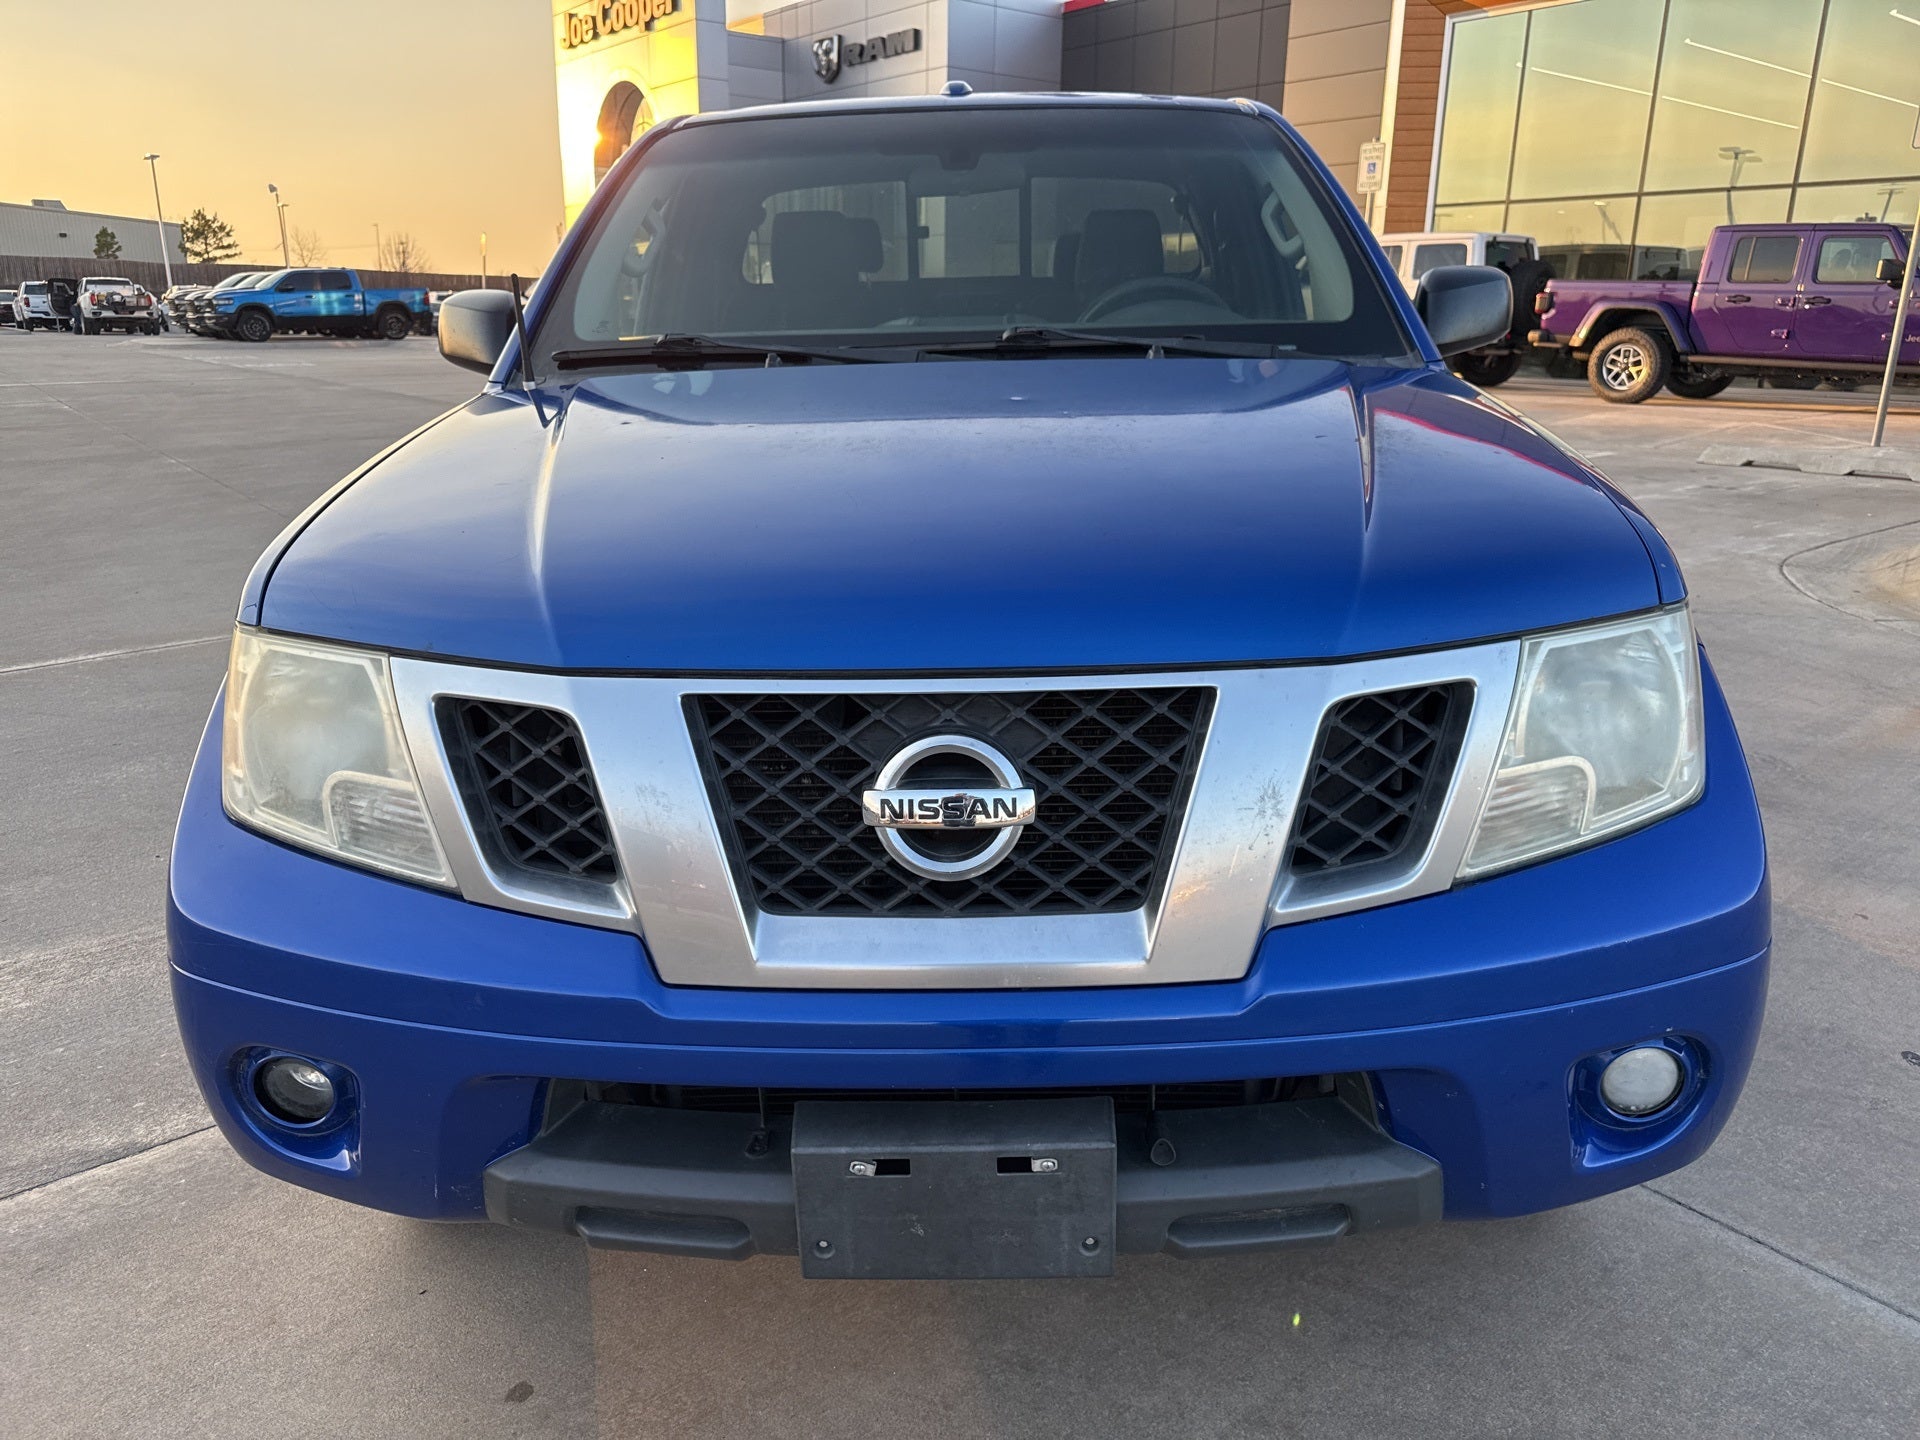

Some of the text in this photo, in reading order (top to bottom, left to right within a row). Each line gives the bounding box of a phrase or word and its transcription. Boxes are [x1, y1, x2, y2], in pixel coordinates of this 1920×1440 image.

[562, 13, 594, 49] Joe
[844, 28, 920, 66] RAM
[879, 796, 1018, 821] NISSAN
